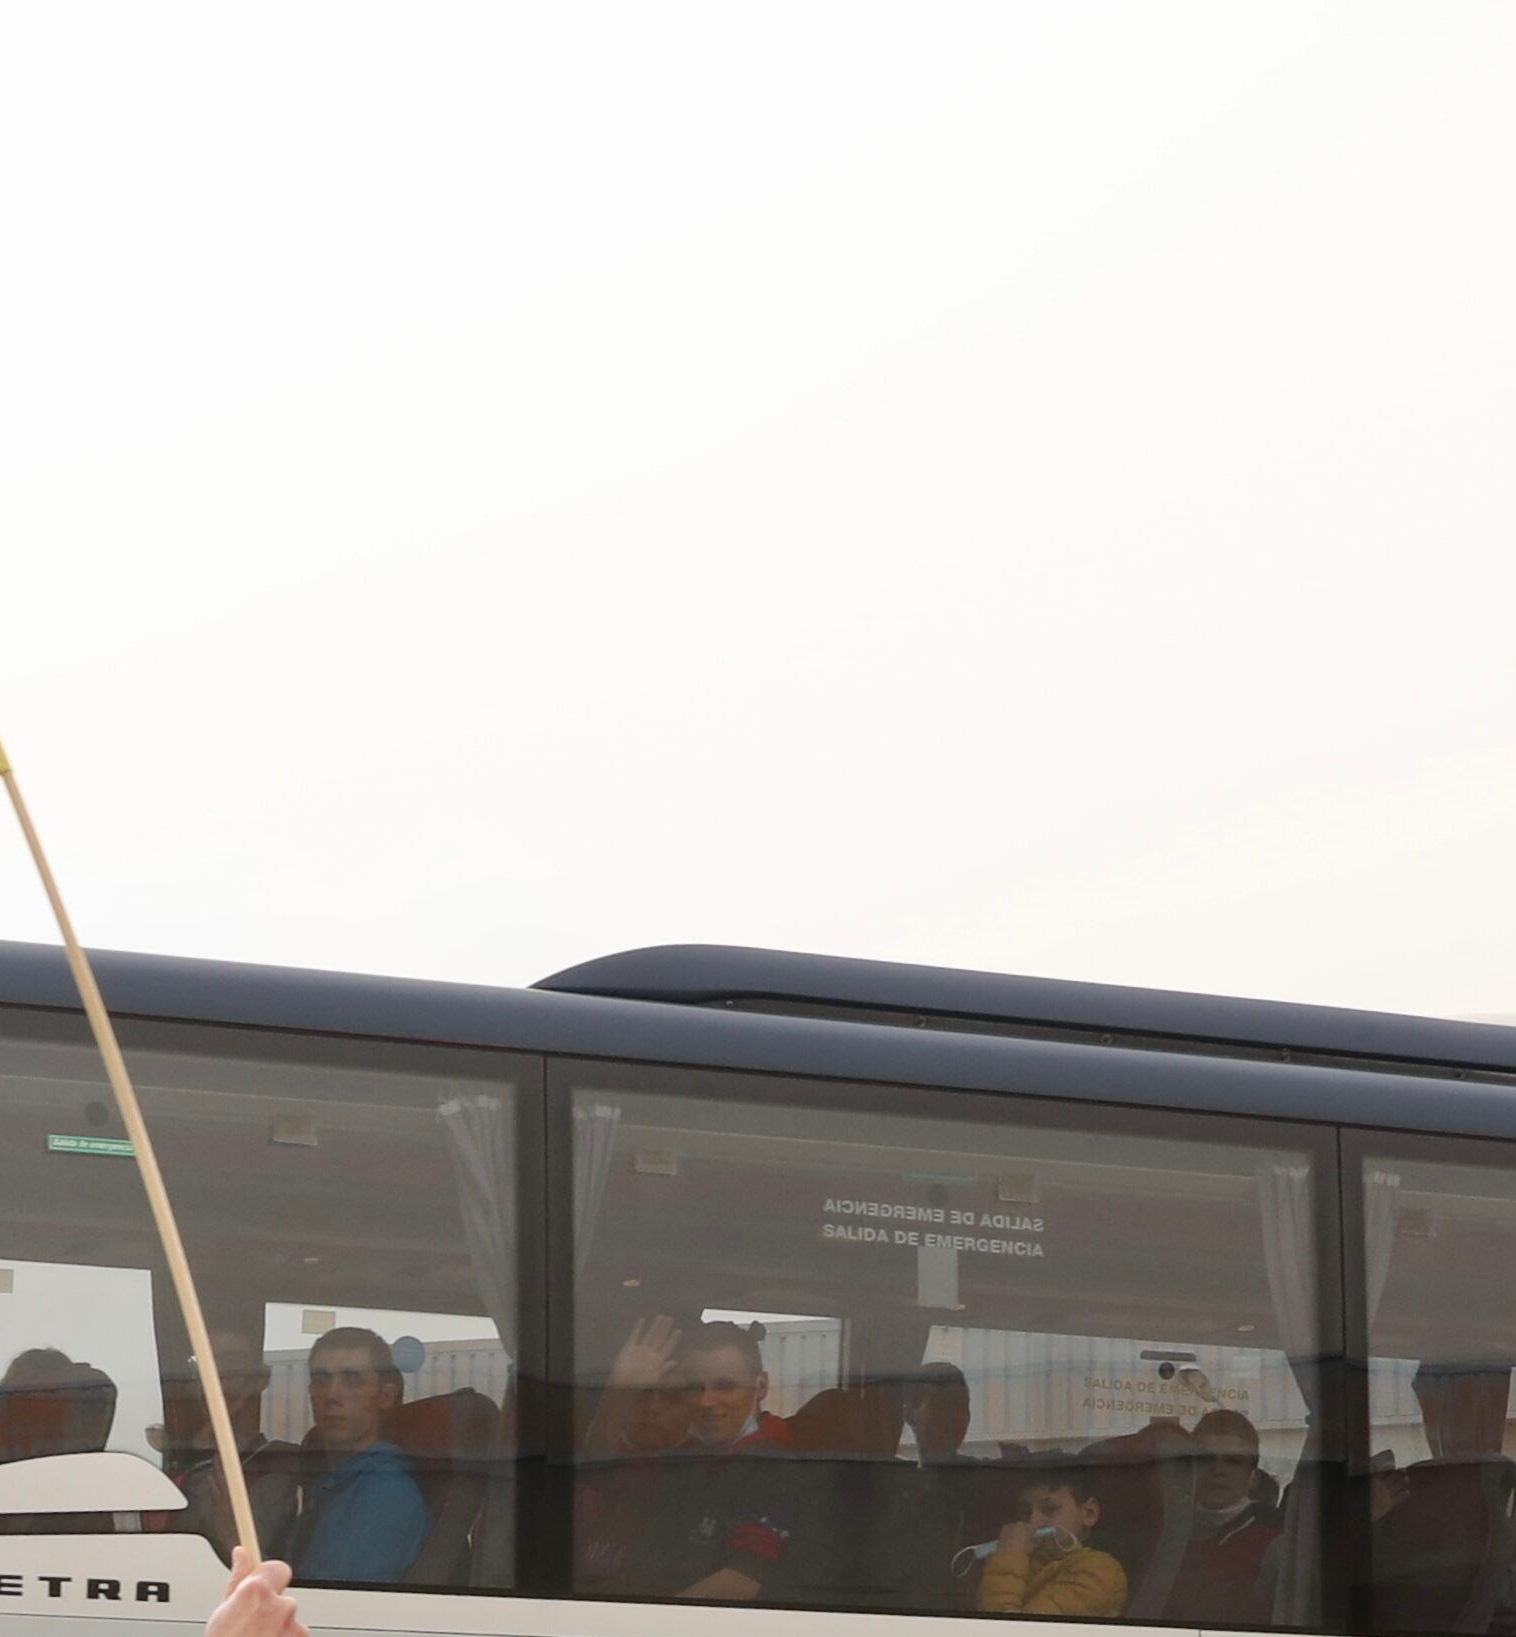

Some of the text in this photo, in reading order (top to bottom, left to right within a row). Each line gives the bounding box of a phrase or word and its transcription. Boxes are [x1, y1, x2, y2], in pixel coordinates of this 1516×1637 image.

[822, 1223, 1044, 1258] SALIDA DE EMERGENCIA
[1083, 1376, 1133, 1392] SALIDA
[1137, 1381, 1156, 1393] DE
